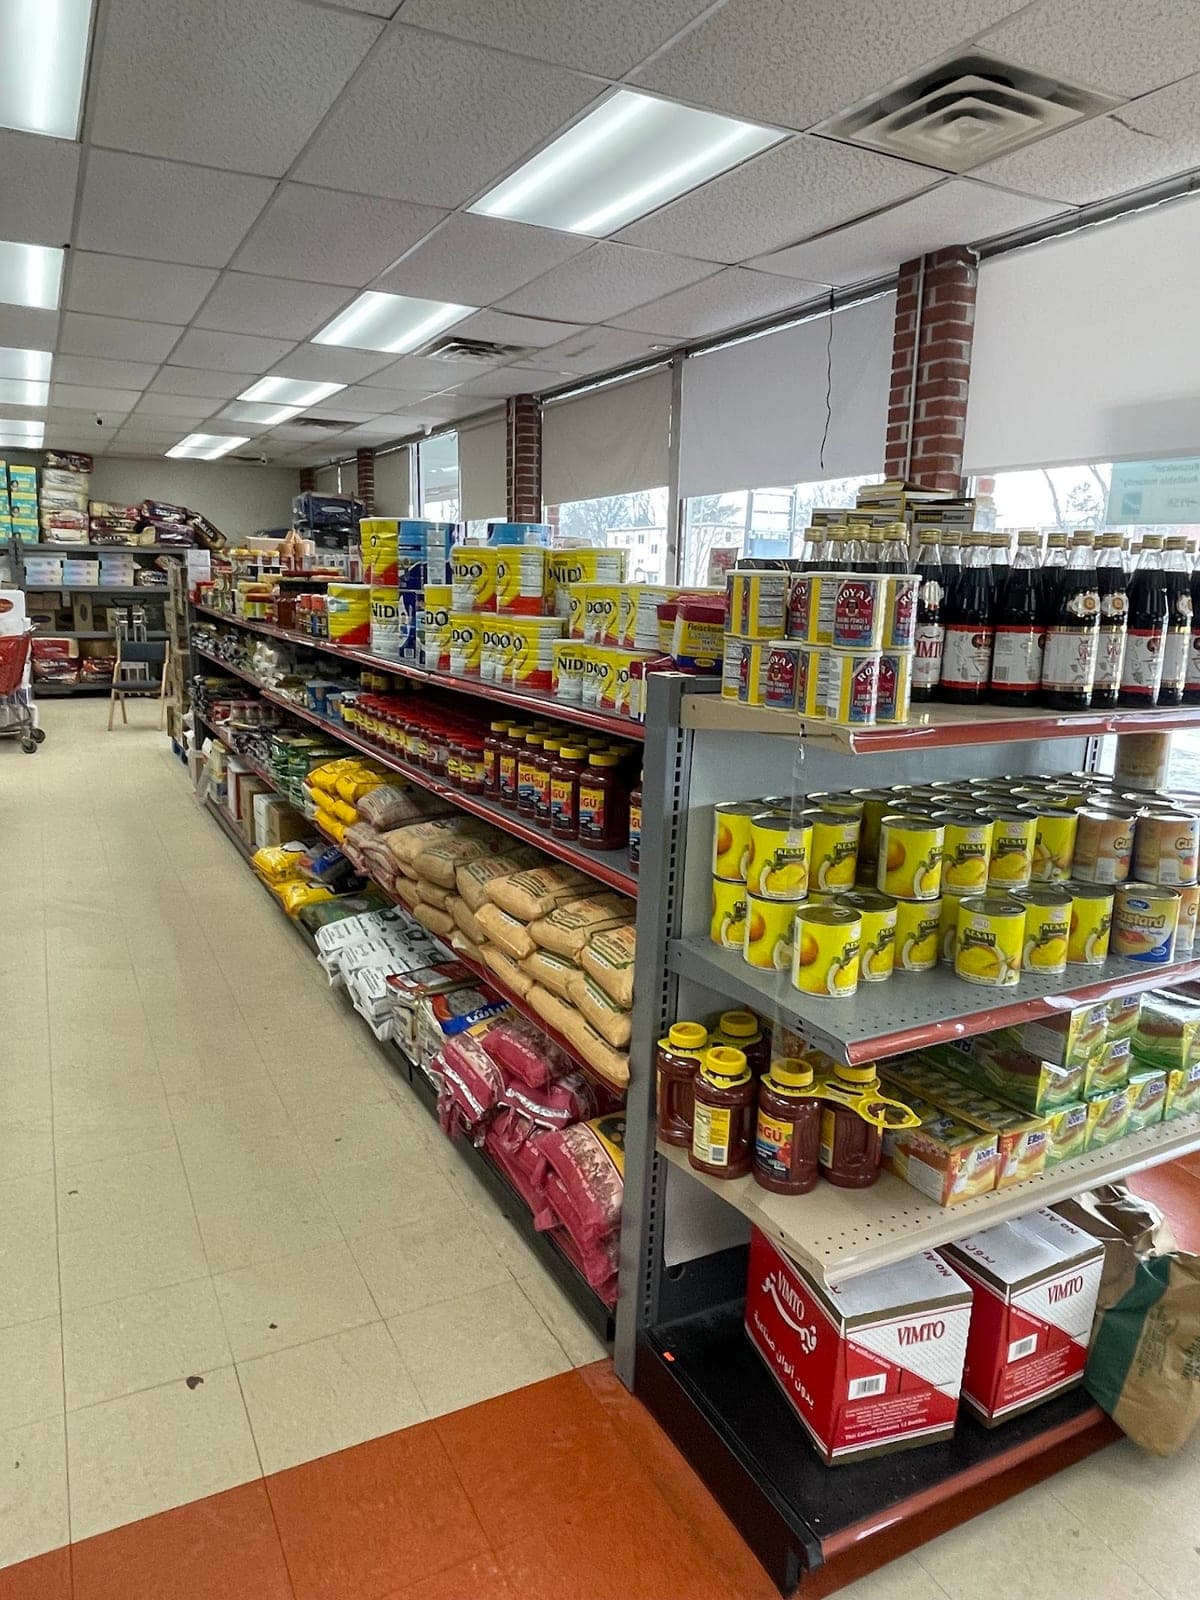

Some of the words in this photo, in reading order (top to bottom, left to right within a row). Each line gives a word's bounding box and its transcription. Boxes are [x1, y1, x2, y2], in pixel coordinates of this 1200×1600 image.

[791, 586, 806, 600] ROY
[838, 588, 874, 605] ROYAL
[371, 602, 399, 618] NID
[452, 629, 473, 642] DO
[915, 640, 943, 658] IMT
[768, 656, 793, 671] OYAL
[857, 665, 875, 682] ROY
[1115, 910, 1166, 929] ustard
[779, 1270, 805, 1320] VIMTO
[1047, 1275, 1084, 1305] VIMTO
[897, 1320, 945, 1346] VIMTO
